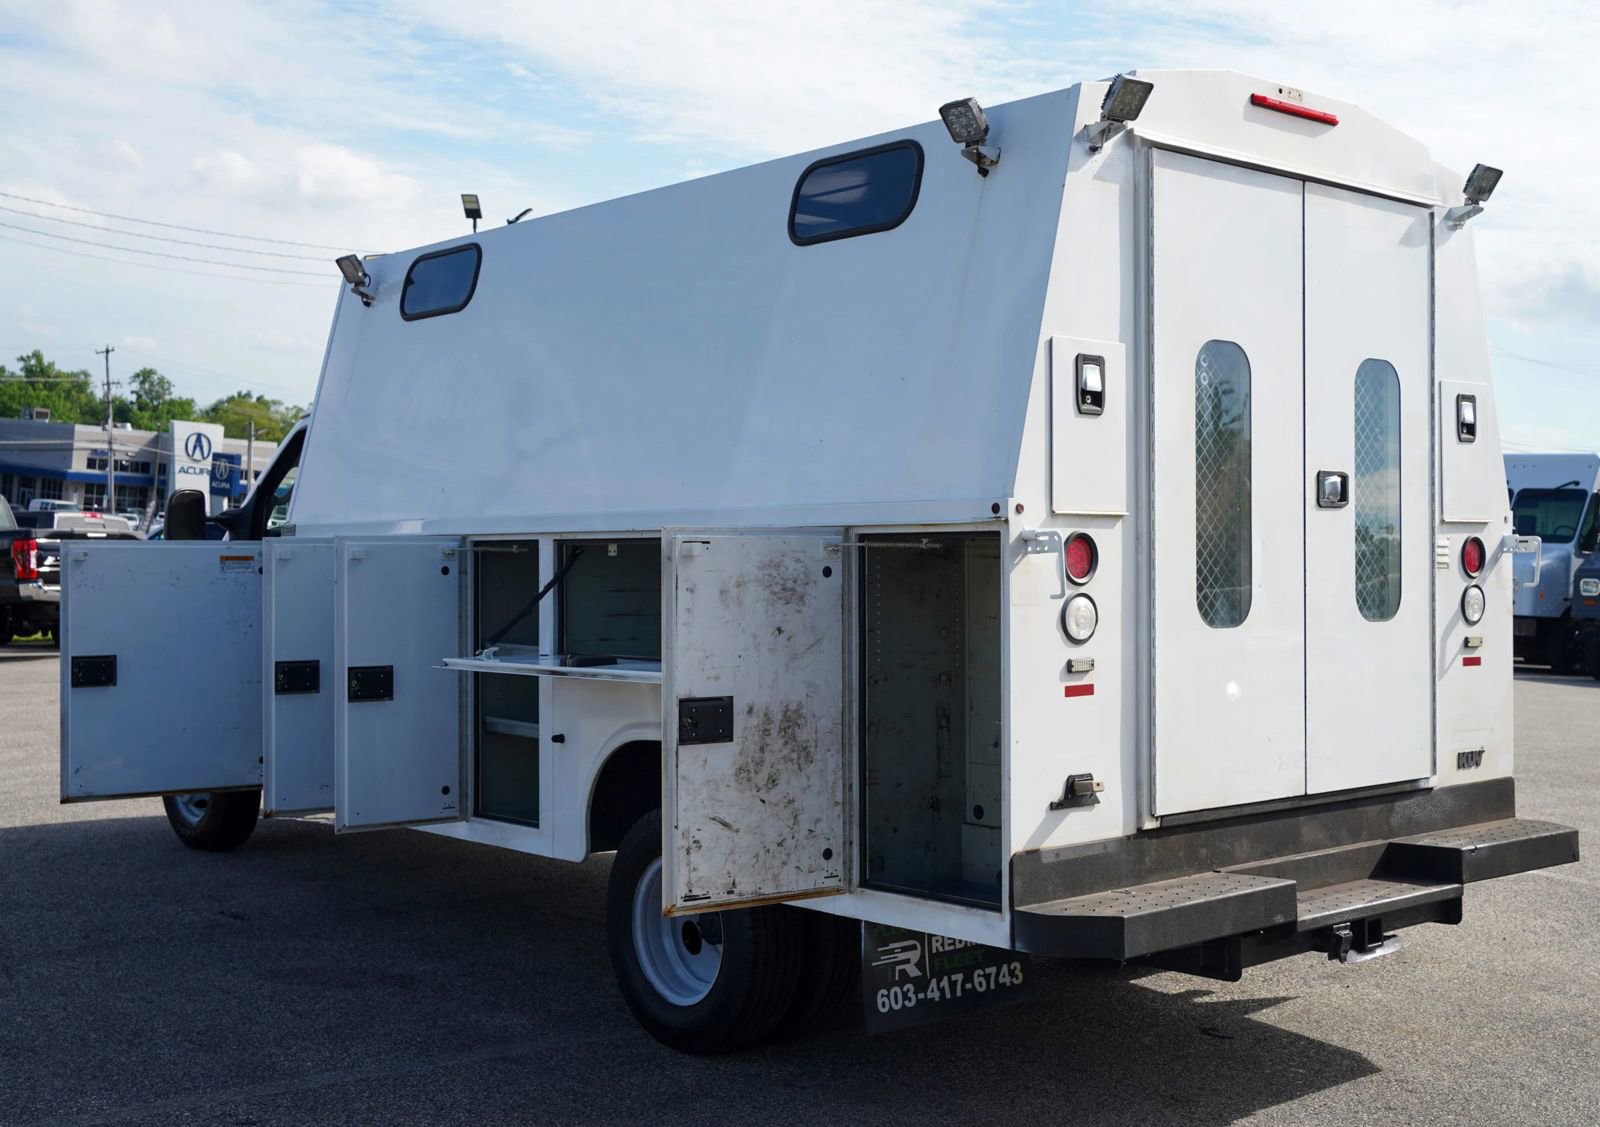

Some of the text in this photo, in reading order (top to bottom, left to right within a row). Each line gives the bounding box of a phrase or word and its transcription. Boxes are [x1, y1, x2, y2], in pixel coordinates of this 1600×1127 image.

[178, 466, 211, 475] ACUR
[933, 949, 984, 971] FLEET
[876, 961, 1024, 1013] 603-417-6743
